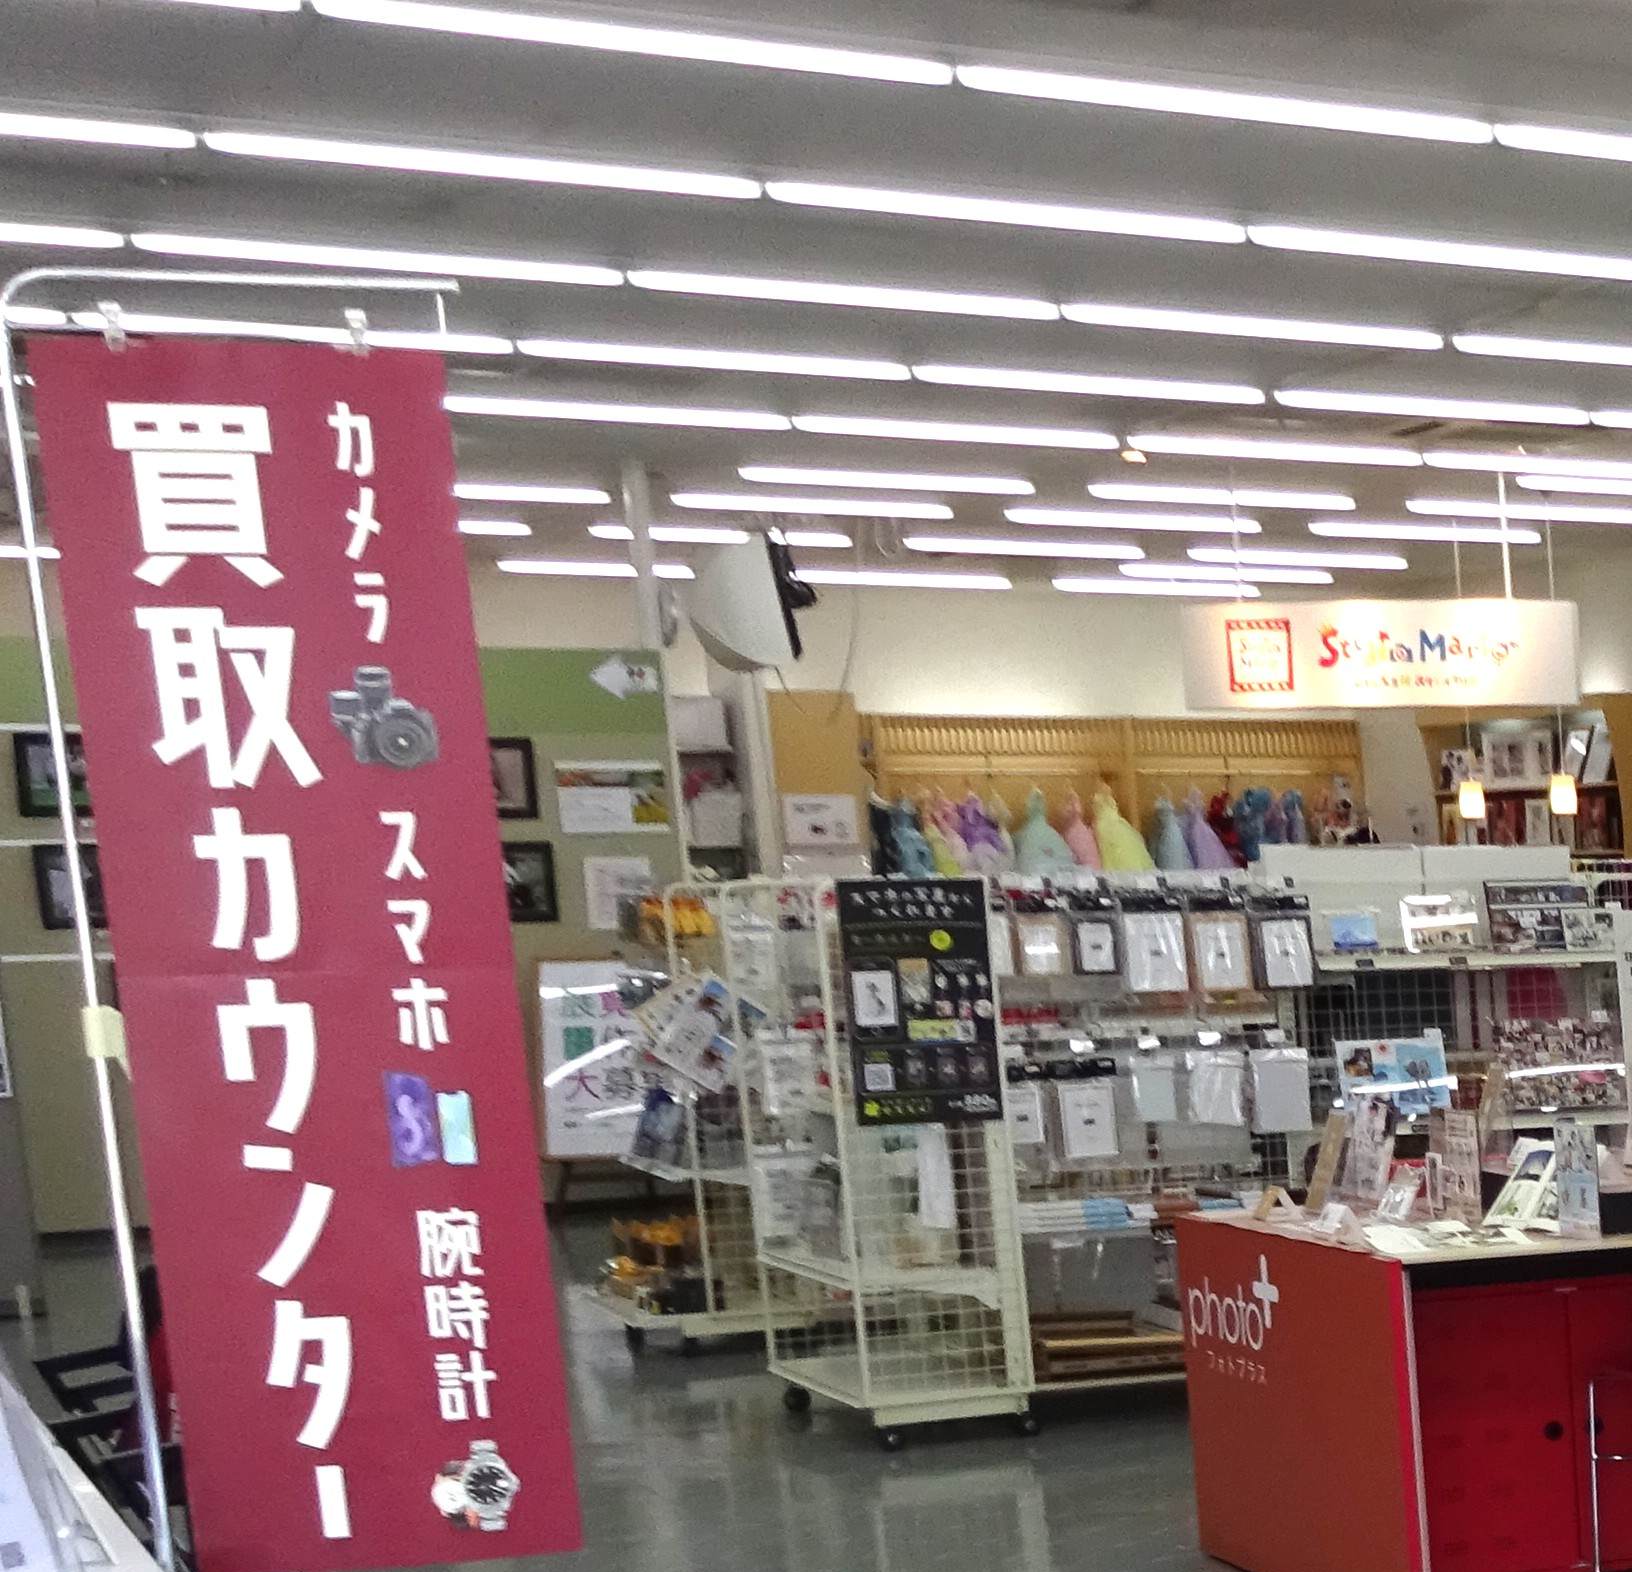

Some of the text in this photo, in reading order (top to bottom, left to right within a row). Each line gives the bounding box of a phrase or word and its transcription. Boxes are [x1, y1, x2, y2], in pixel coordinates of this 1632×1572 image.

[326, 401, 391, 645] カメラ
[106, 401, 353, 1540] 買取カウンター
[379, 809, 451, 1053] スマホ
[414, 1206, 499, 1422] 腕時計
[1207, 1349, 1269, 1385] フォトプラス
